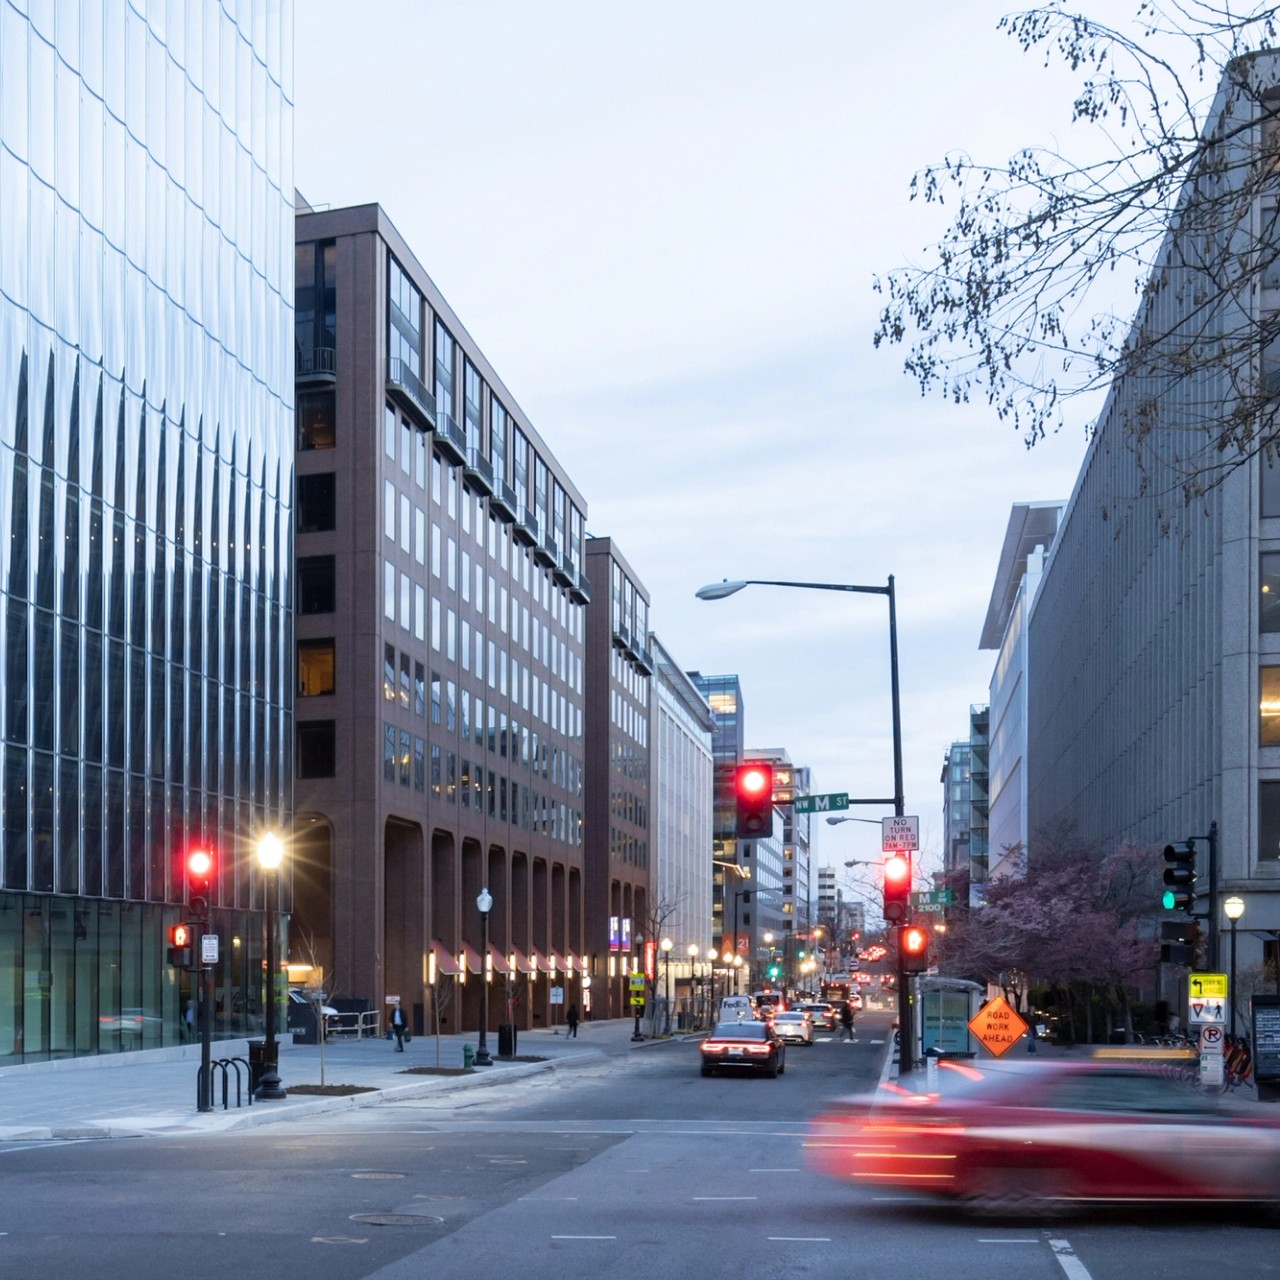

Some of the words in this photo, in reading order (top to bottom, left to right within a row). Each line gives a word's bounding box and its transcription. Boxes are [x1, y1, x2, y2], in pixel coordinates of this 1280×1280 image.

[796, 800, 809, 809] NW
[815, 796, 830, 810] M
[836, 797, 847, 806] ST
[890, 826, 911, 834] TURN
[919, 893, 930, 904] M
[918, 904, 941, 912] 2100
[987, 1023, 1010, 1031] WORK
[983, 1034, 1013, 1043] AHEAD
